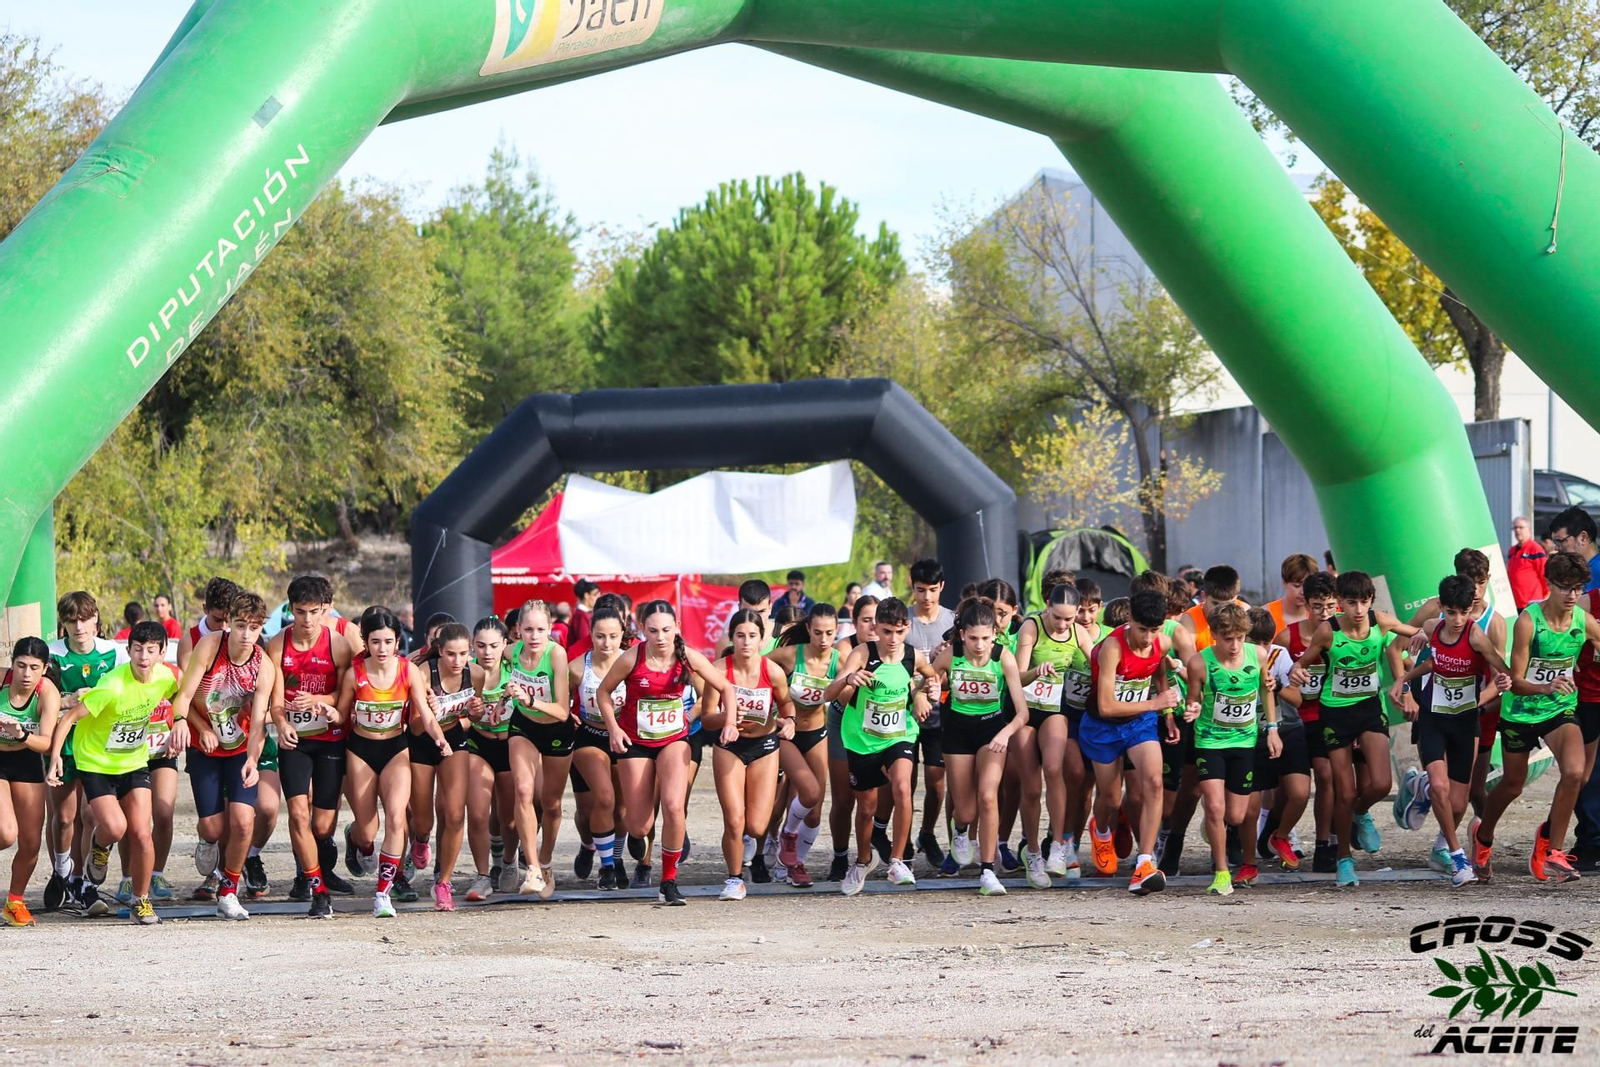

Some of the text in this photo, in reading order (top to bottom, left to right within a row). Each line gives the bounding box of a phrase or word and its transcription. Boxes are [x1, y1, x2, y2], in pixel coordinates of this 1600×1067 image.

[126, 143, 310, 369] DIPUTACIÓN
[166, 207, 292, 365] DE JAÉN
[958, 681, 991, 695] 493
[1340, 675, 1371, 689] 498
[800, 688, 822, 702] 28
[1034, 682, 1054, 698] 81
[1116, 689, 1144, 702] 101
[1444, 688, 1464, 702] 95
[365, 710, 396, 724] 137
[1220, 703, 1251, 718] 492
[646, 710, 677, 726] 146
[871, 711, 900, 727] 500
[115, 727, 145, 743] 384
[584, 725, 610, 738] NIKE
